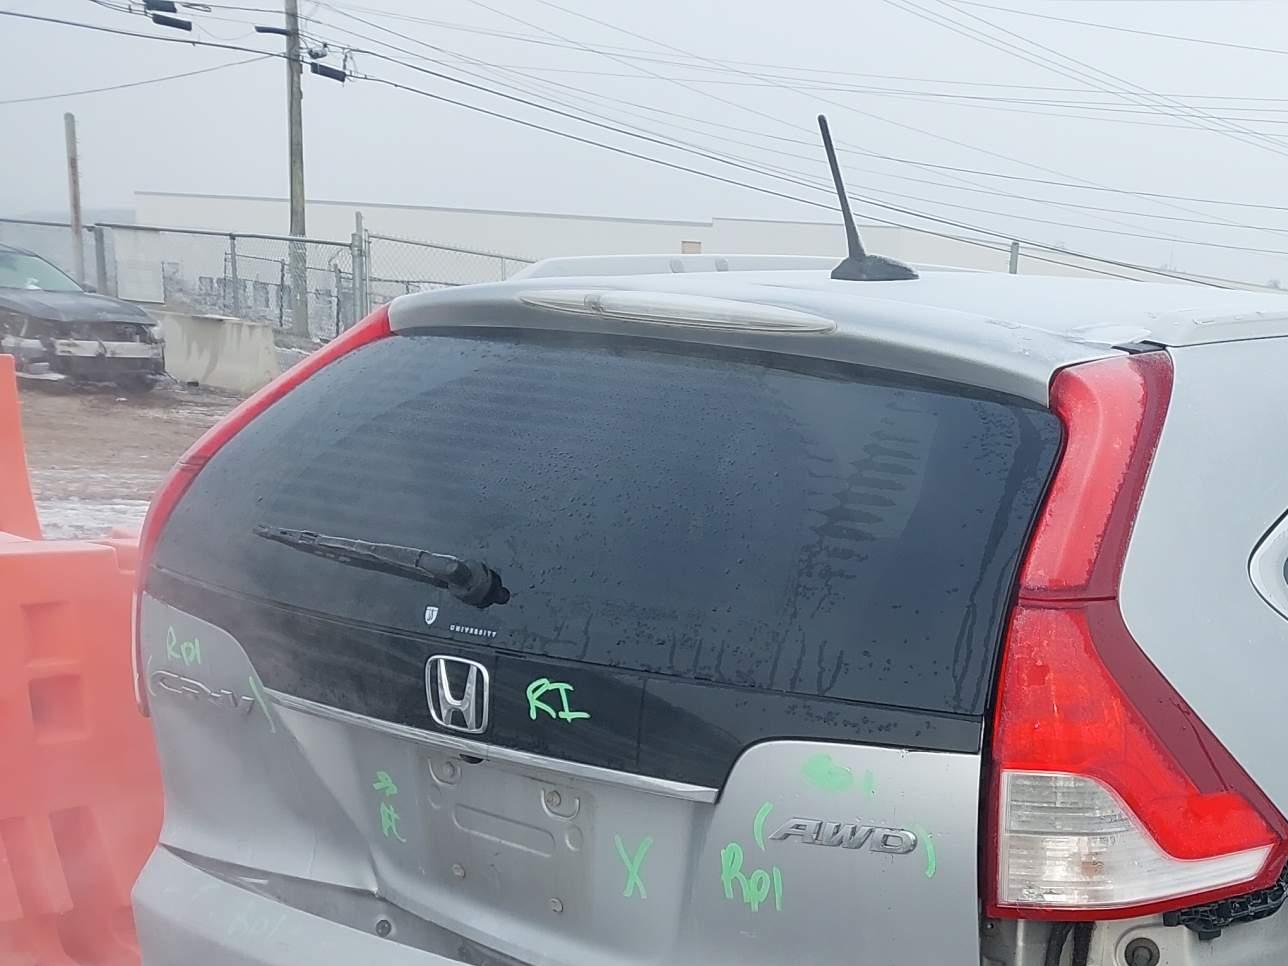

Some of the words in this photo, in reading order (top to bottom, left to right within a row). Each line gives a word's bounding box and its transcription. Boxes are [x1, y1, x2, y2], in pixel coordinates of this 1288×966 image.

[449, 624, 497, 638] UNIVERSITY
[526, 678, 591, 722] RI
[768, 816, 918, 855] AWD
